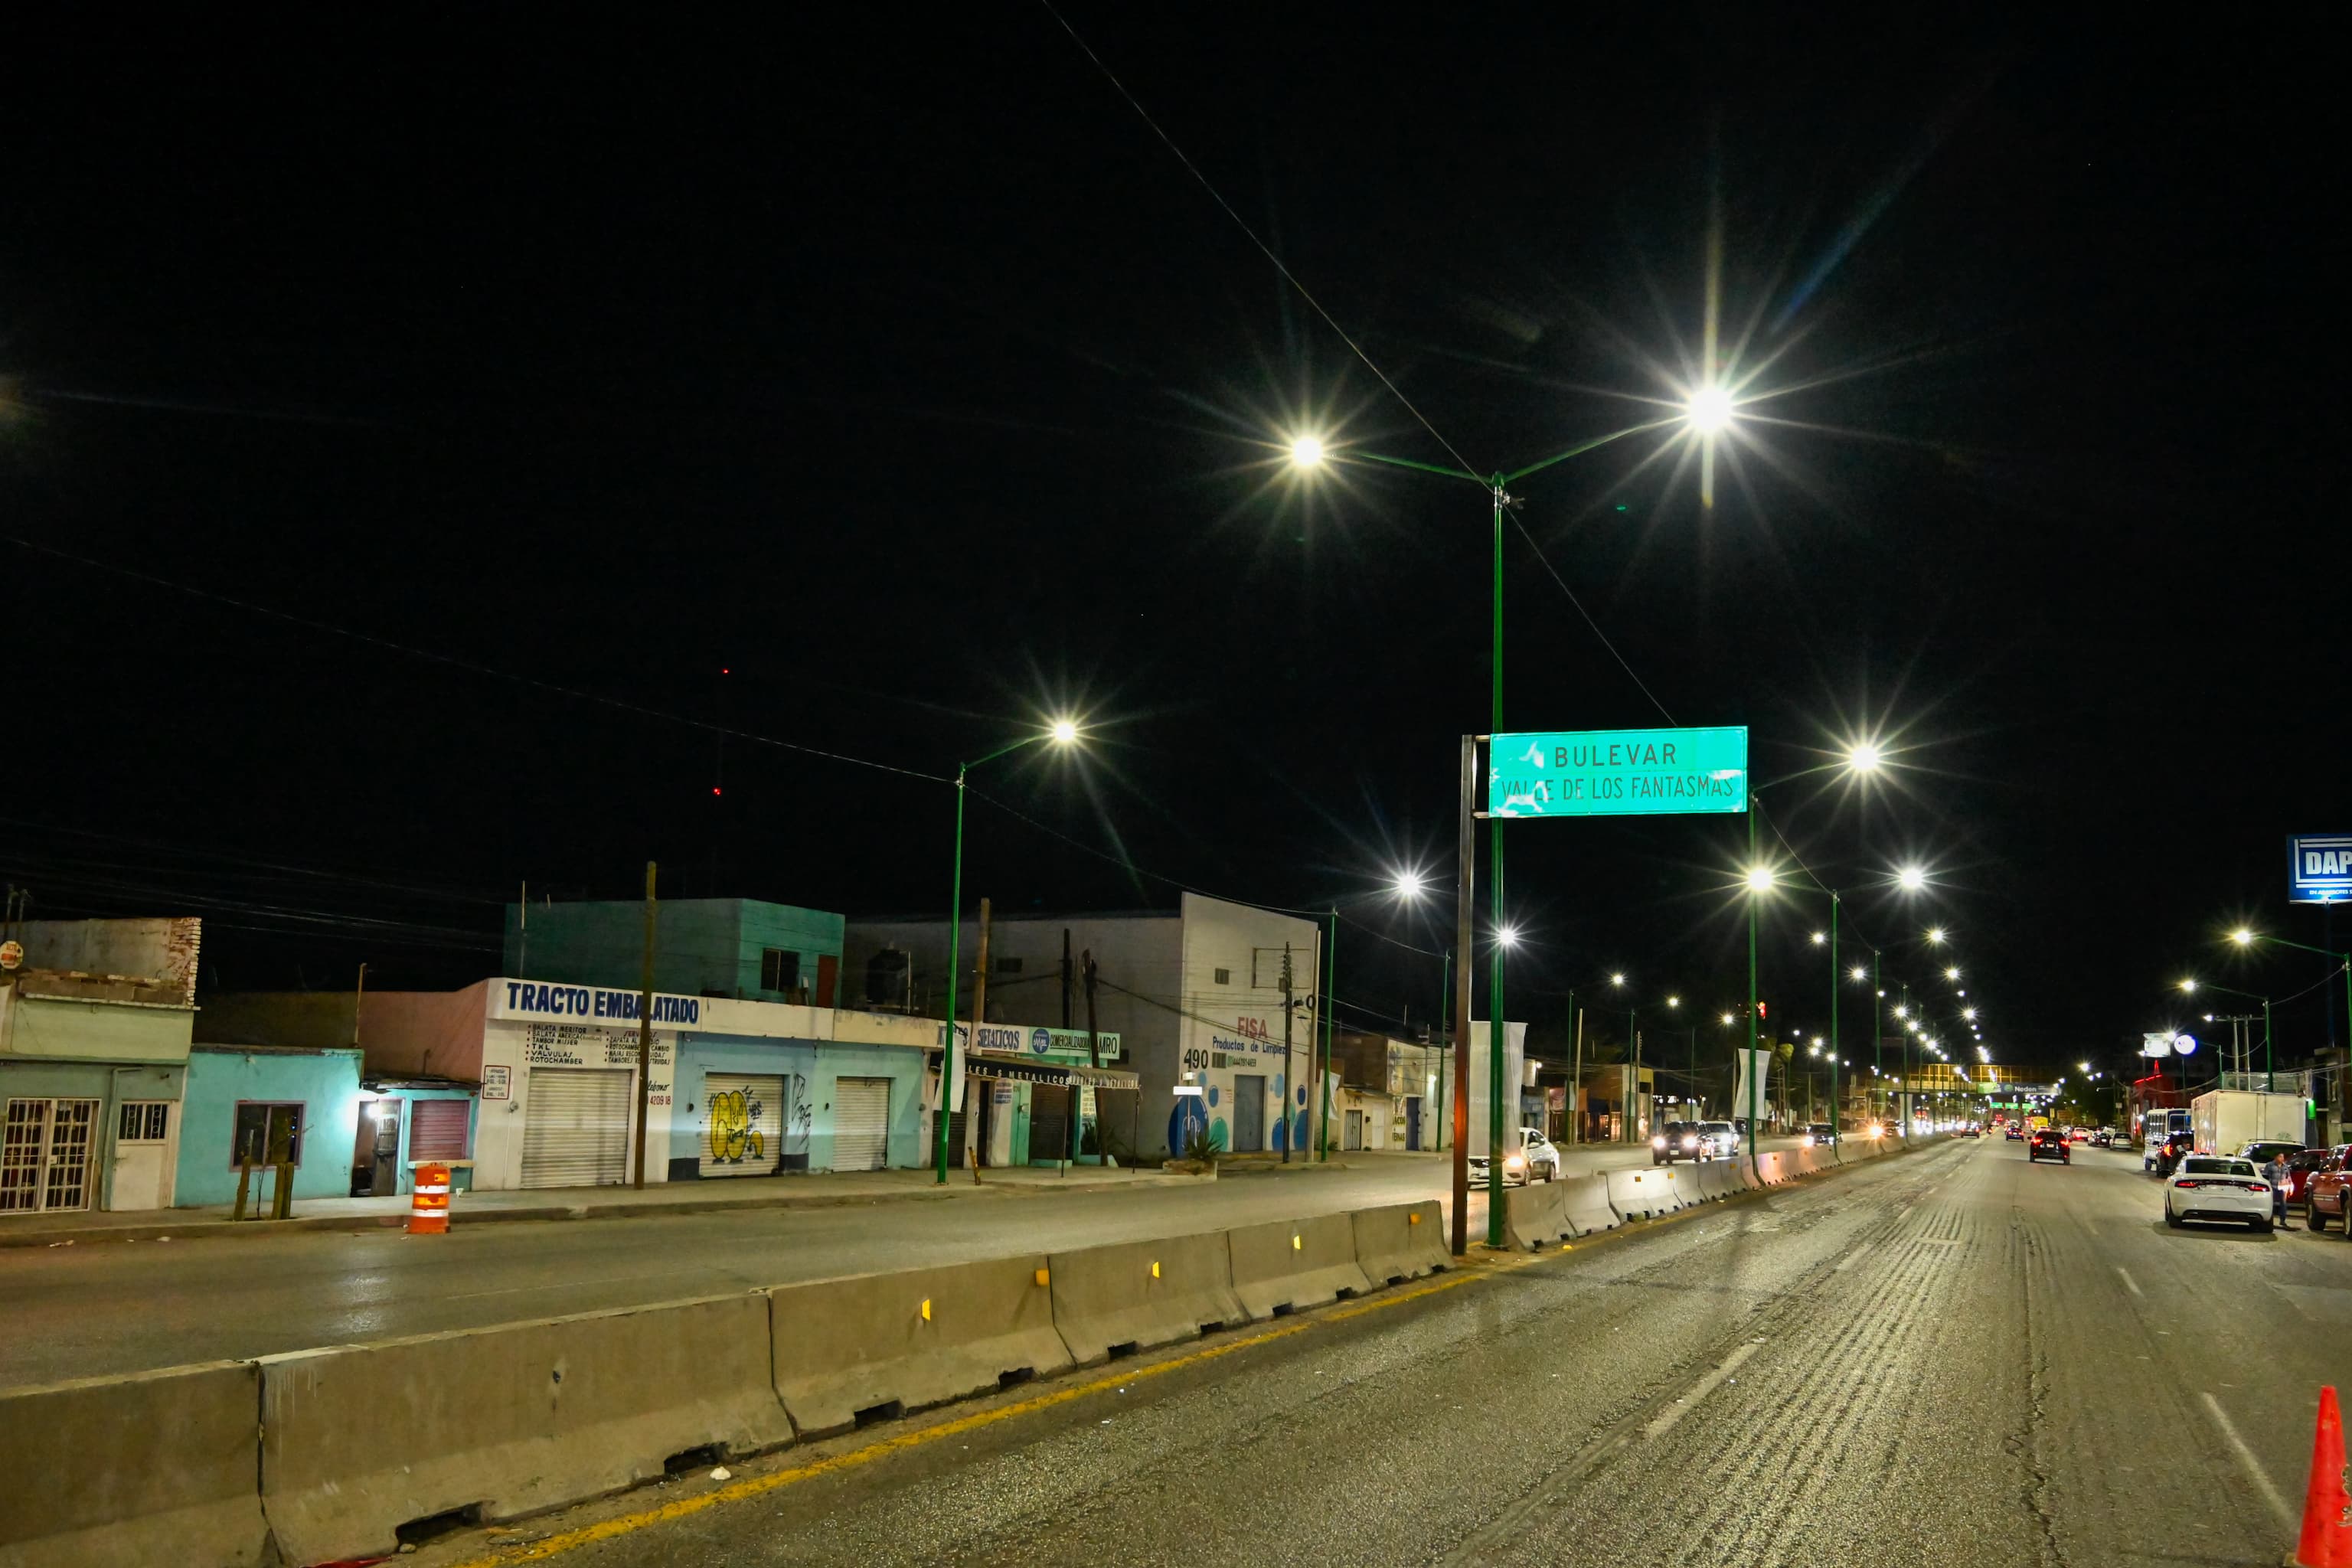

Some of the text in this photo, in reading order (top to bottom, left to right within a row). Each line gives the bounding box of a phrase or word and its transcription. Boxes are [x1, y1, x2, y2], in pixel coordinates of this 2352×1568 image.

[1555, 743, 1676, 768] BULEVAR
[1563, 778, 1584, 800] DE
[1592, 777, 1623, 799] LOS
[1632, 775, 1733, 799] FANTASMAS
[507, 982, 698, 1024] TRACTO EMBAATADO
[1237, 1016, 1268, 1039] FISA
[1213, 1035, 1245, 1051] Productos
[1250, 1039, 1259, 1053] de
[530, 1056, 583, 1065] ROTOCHAMBER
[1184, 1048, 1208, 1070] 490
[1008, 1070, 1070, 1086] METALICOS
